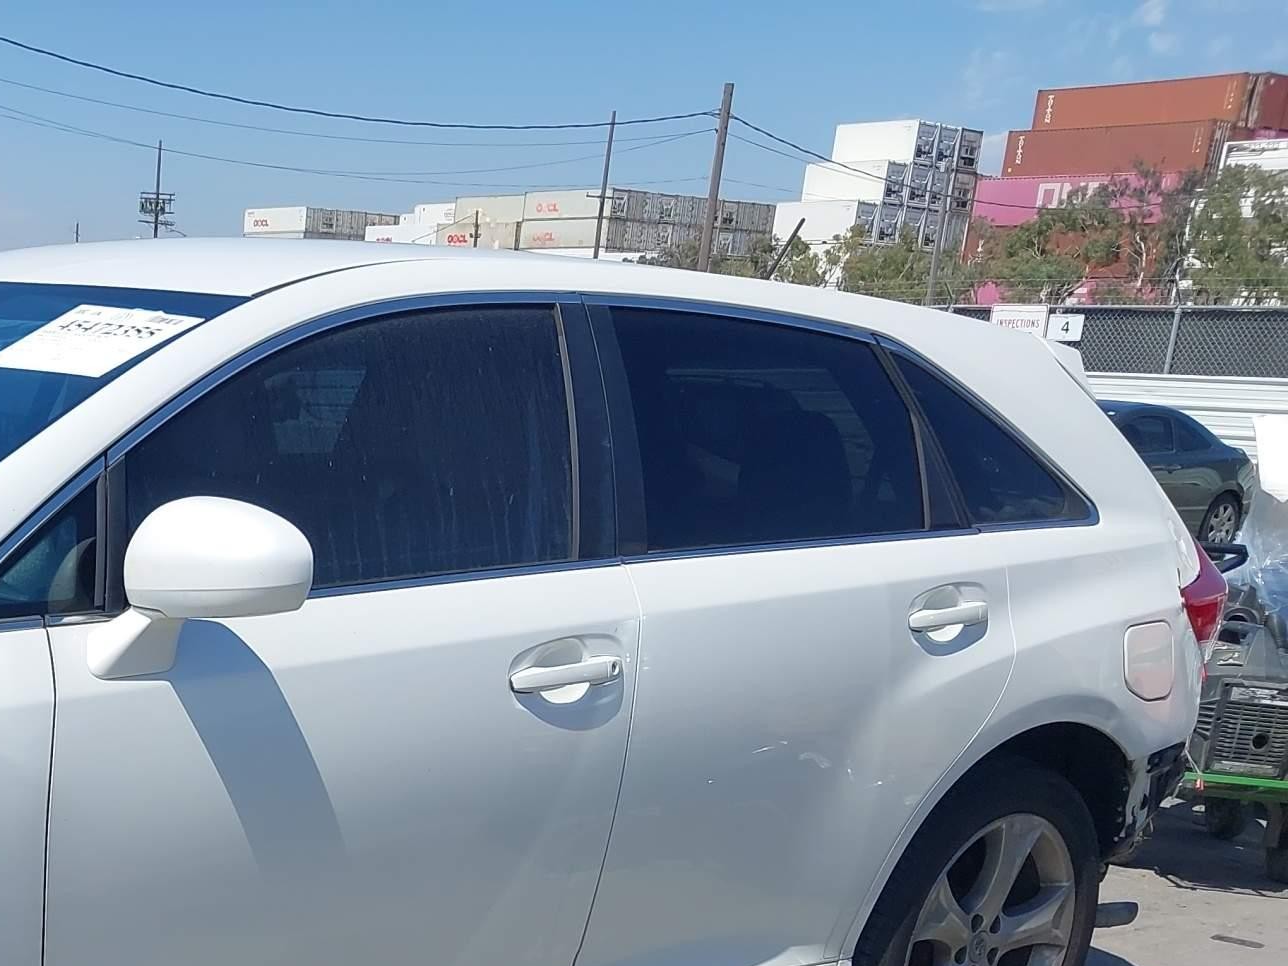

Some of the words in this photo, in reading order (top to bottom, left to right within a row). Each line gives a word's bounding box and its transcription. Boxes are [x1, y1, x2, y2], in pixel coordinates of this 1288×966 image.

[447, 234, 468, 244] OOCL
[997, 319, 1040, 329] INSPECTIONS
[1060, 321, 1070, 334] 4
